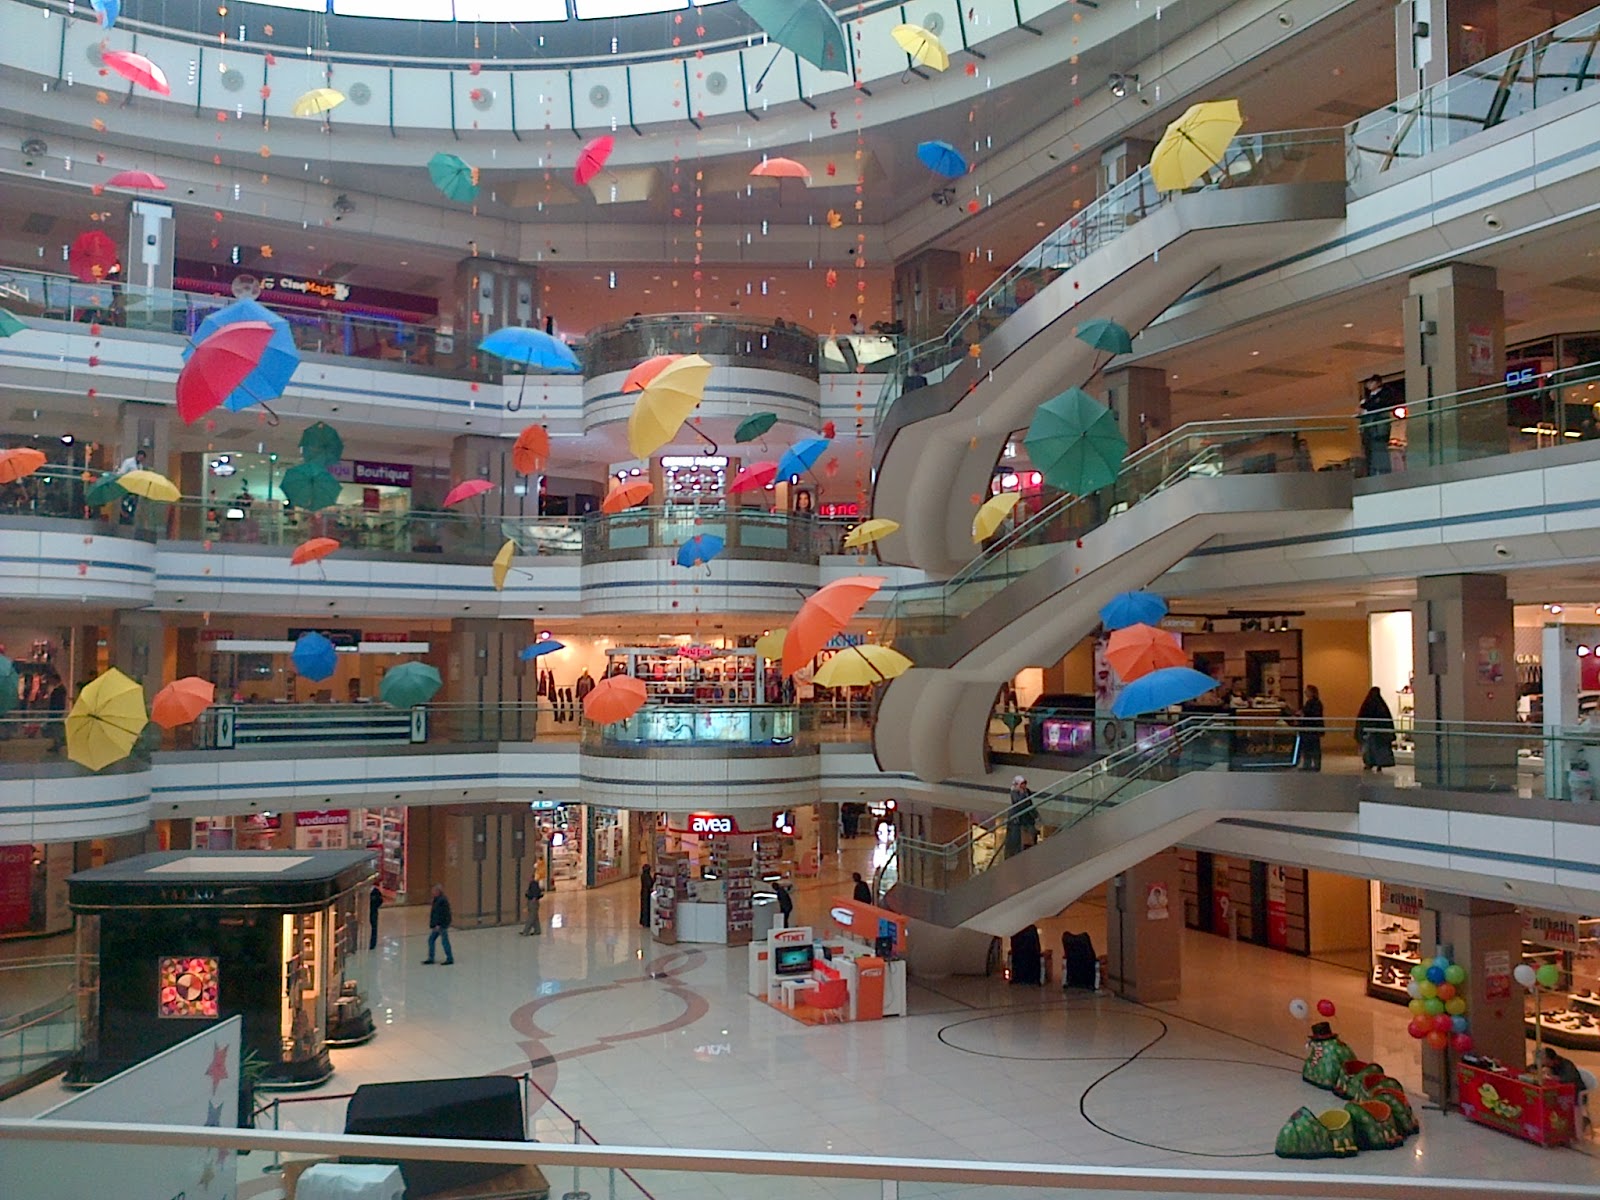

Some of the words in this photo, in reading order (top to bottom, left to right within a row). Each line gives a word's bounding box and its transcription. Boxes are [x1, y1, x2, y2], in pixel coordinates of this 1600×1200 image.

[356, 464, 410, 483] Boutique
[298, 815, 348, 826] vodafone
[692, 817, 731, 832] avea
